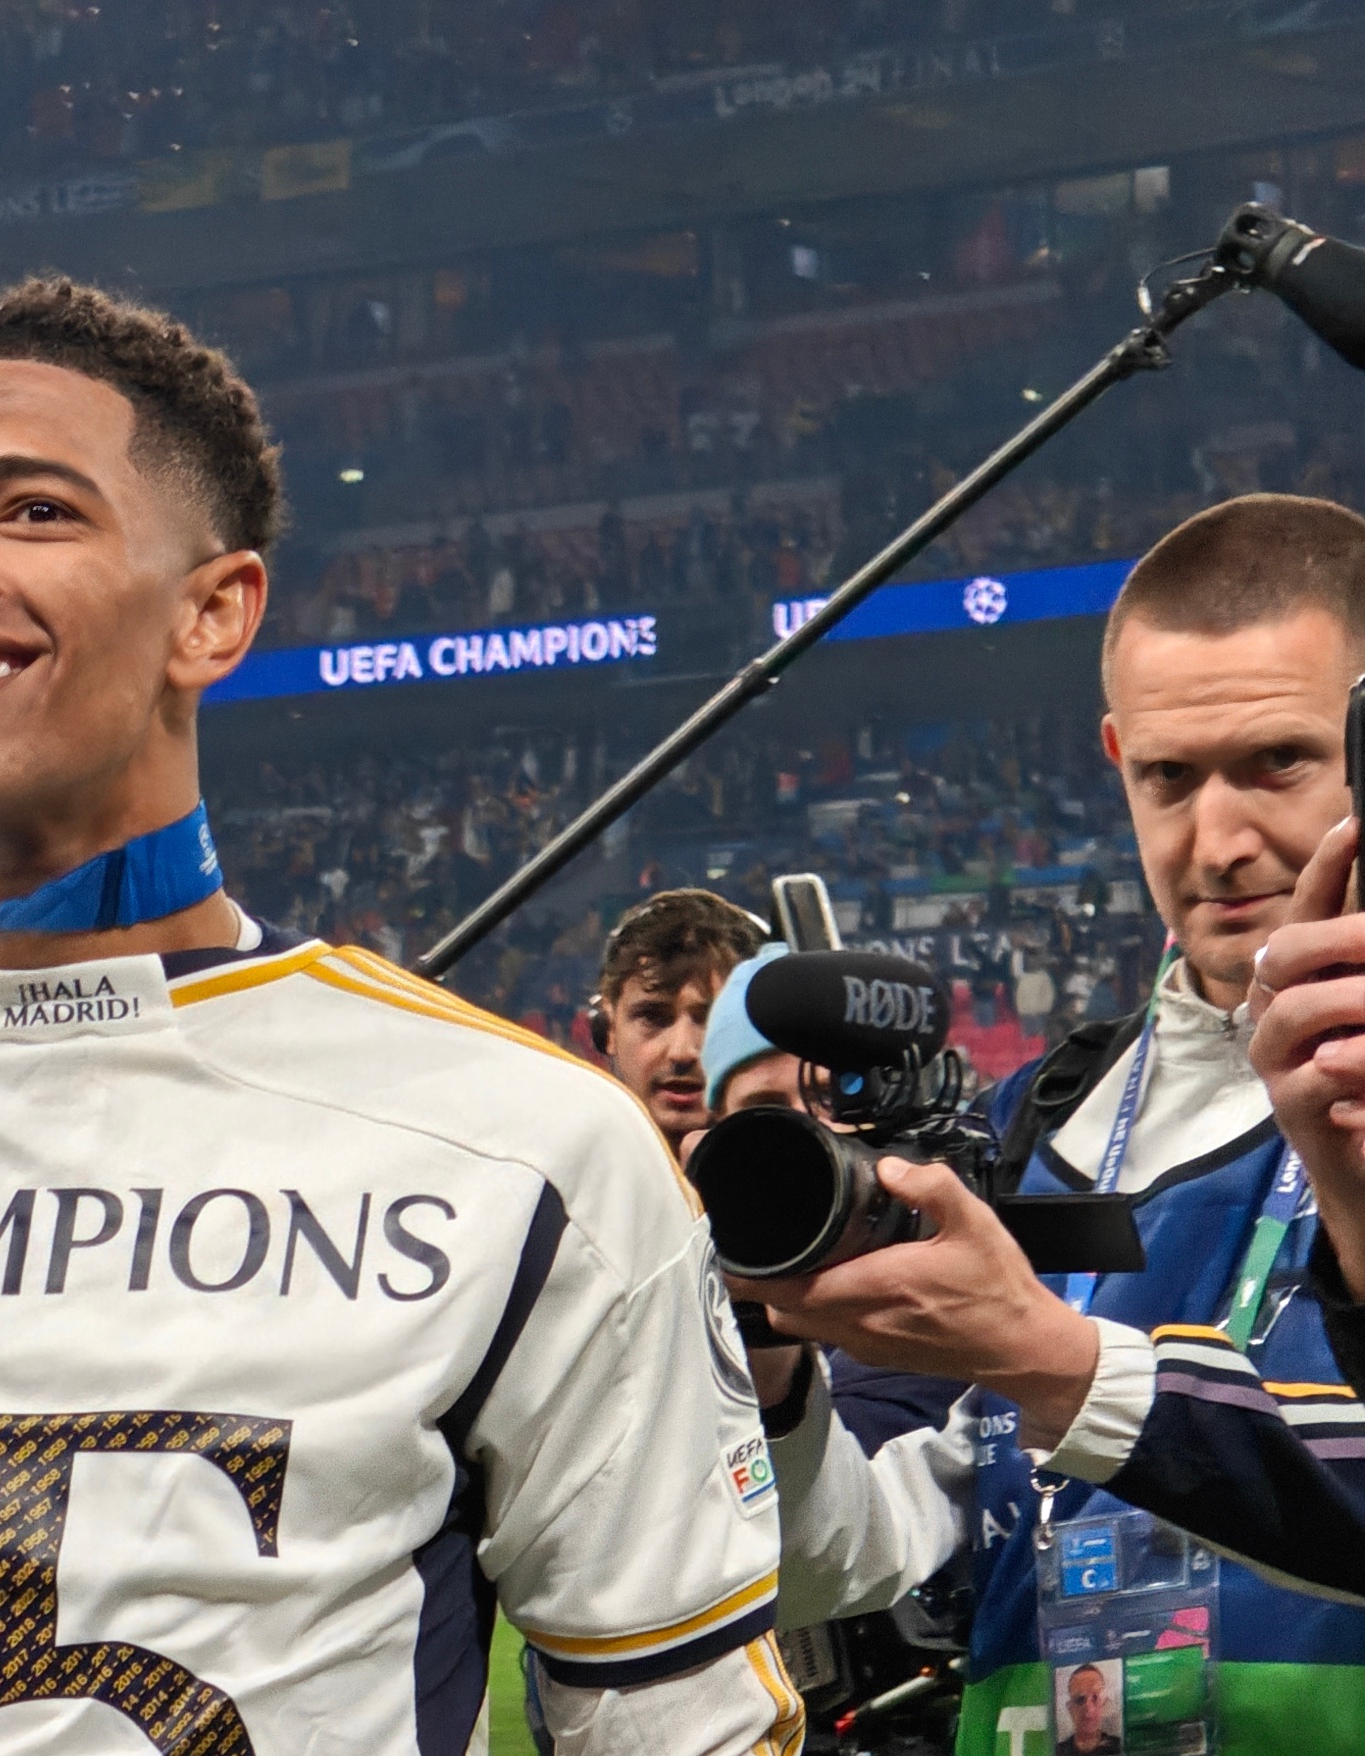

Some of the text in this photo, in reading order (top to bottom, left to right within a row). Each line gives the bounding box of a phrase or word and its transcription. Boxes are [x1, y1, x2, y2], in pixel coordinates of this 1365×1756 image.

[319, 642, 423, 687] UEFA
[3, 996, 141, 1028] MADRID!
[841, 974, 937, 1035] RØDE
